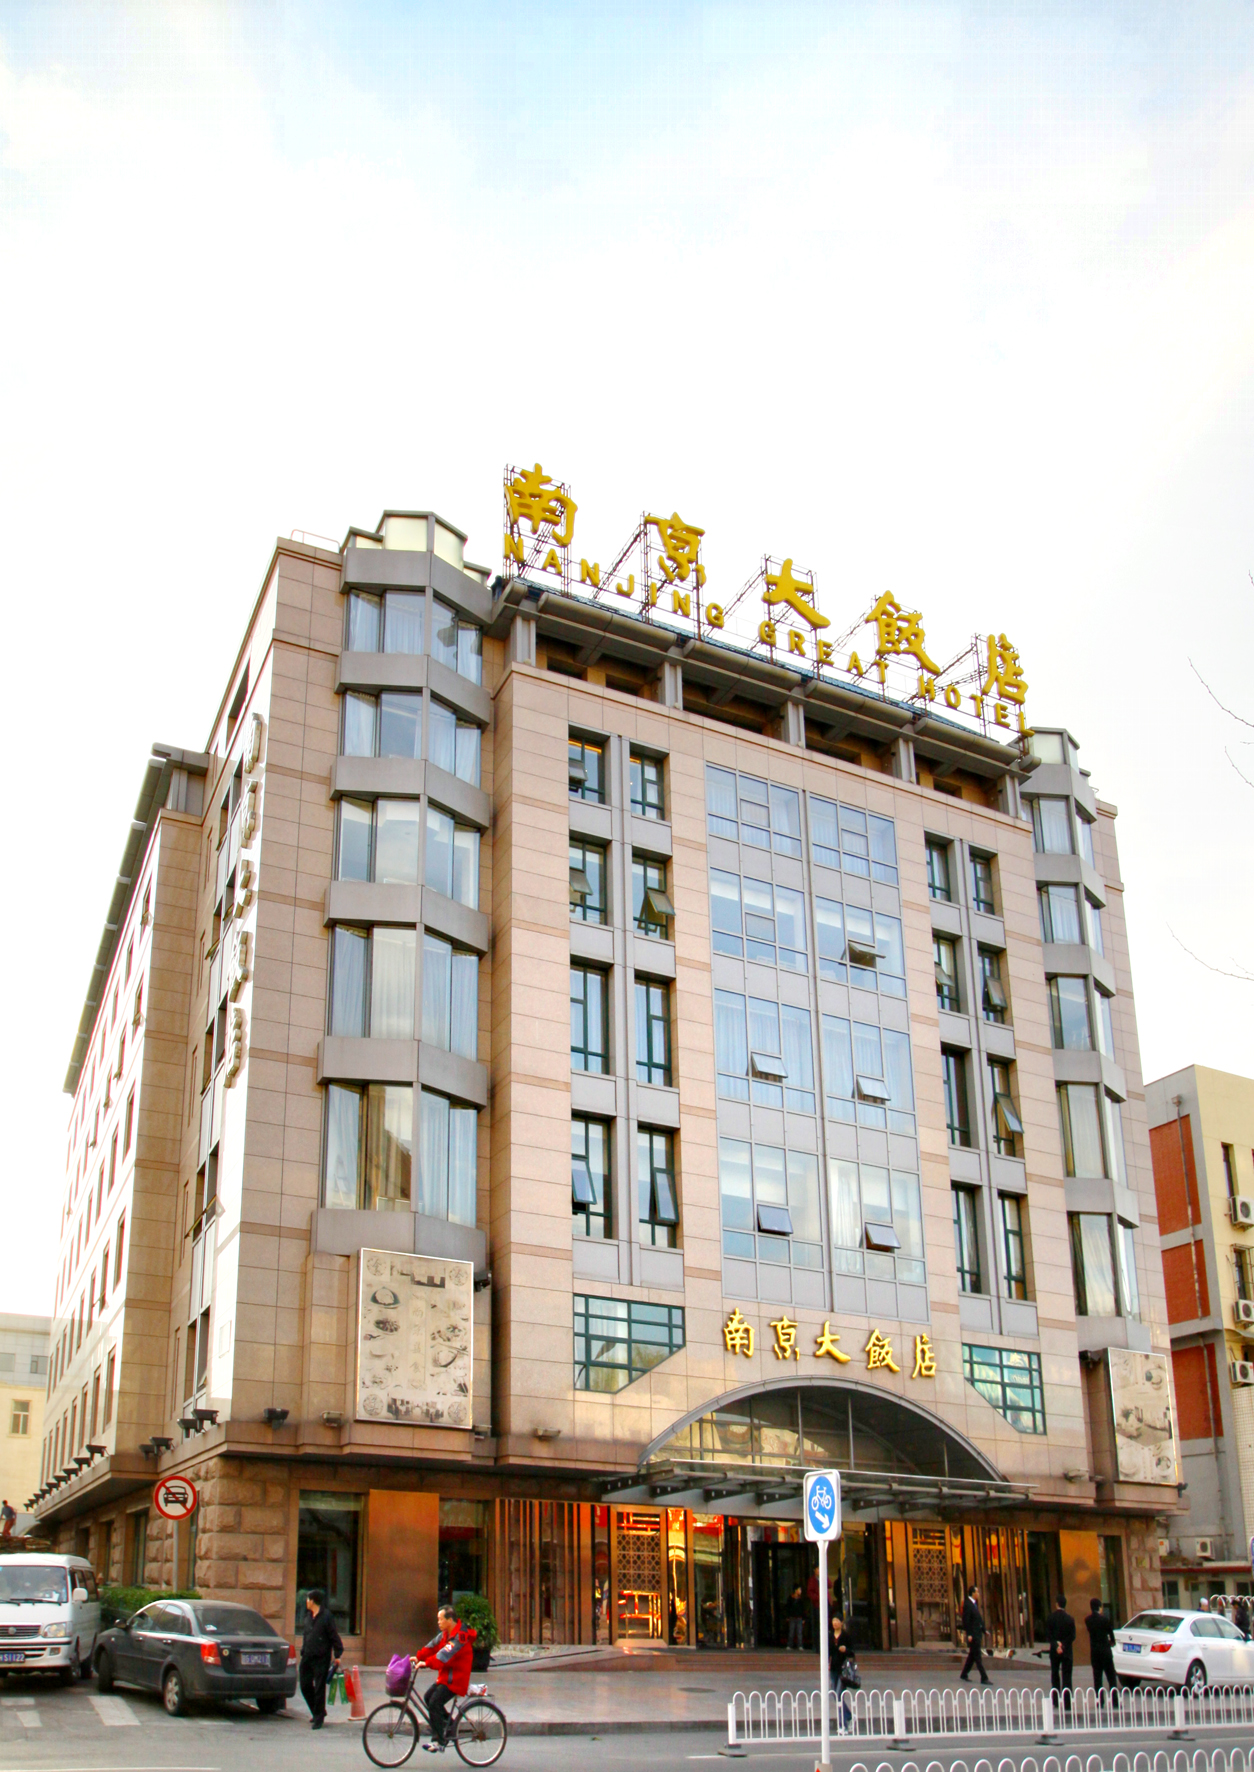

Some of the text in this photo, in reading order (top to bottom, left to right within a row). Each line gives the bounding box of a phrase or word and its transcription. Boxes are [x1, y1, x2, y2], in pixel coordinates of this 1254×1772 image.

[503, 533, 1035, 736] NANJING GREAT HOTEL
